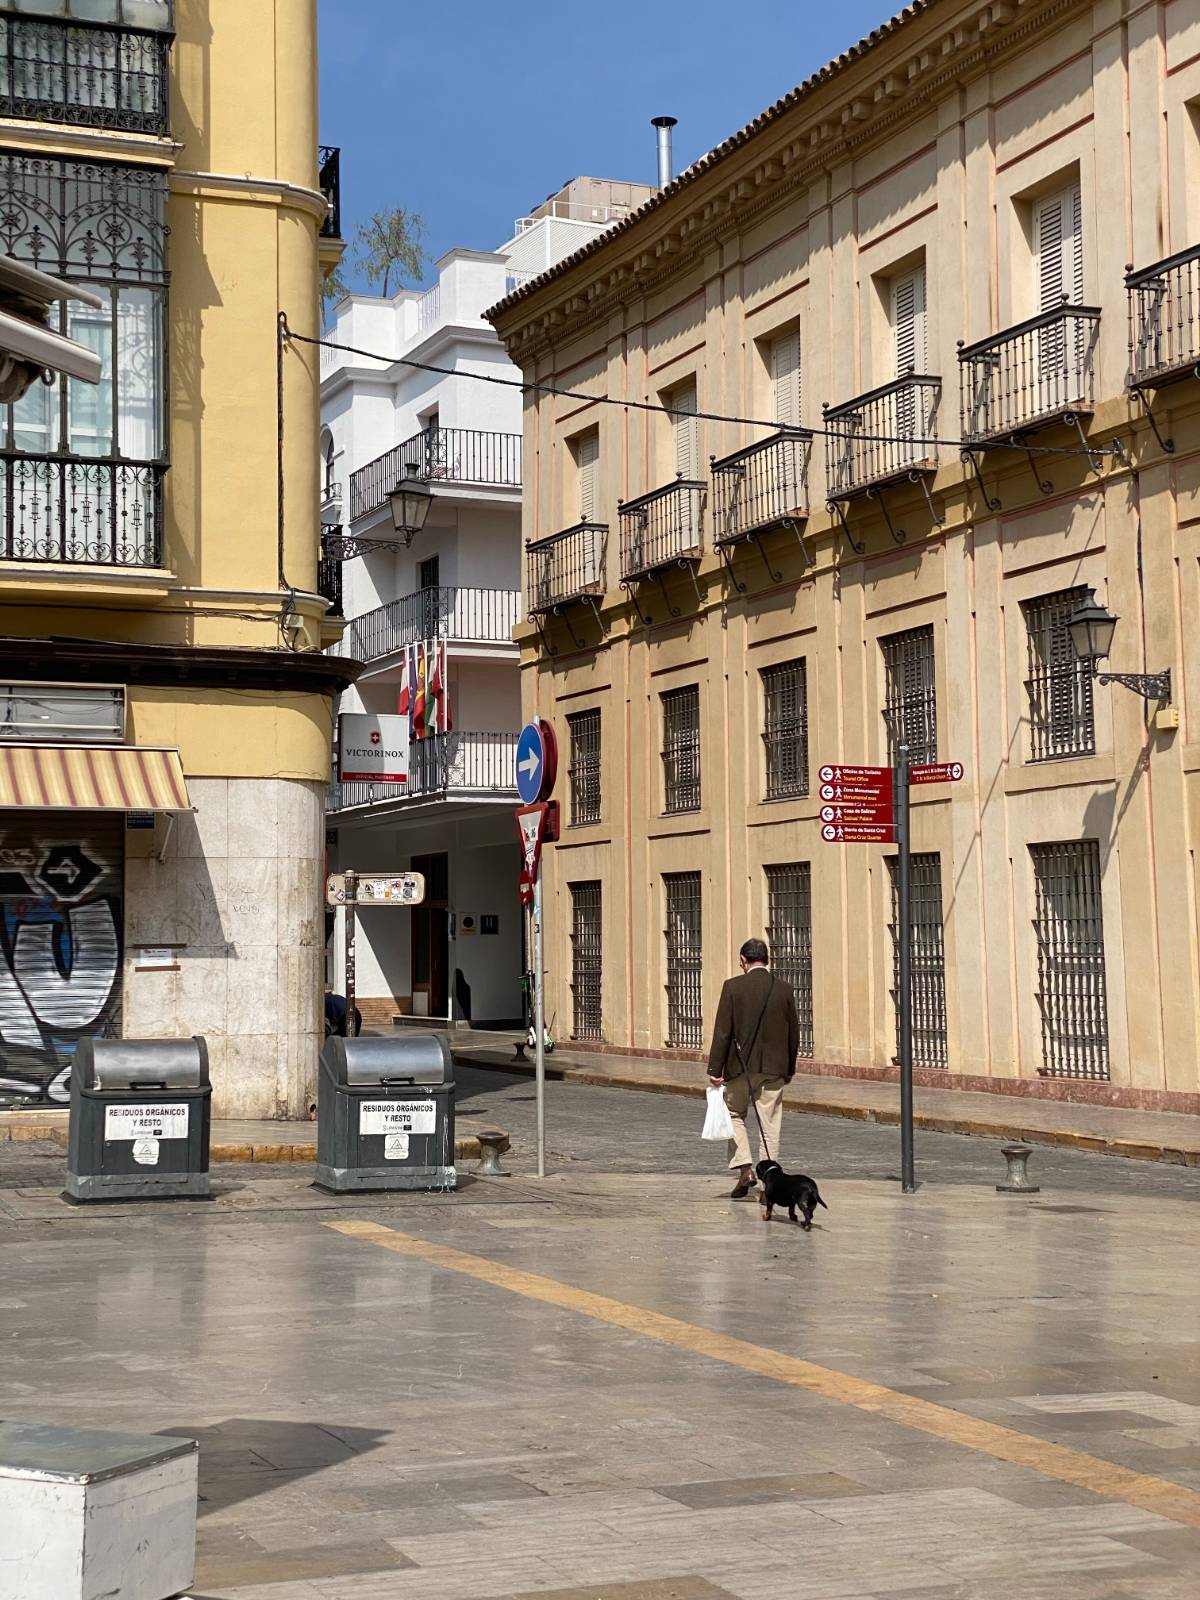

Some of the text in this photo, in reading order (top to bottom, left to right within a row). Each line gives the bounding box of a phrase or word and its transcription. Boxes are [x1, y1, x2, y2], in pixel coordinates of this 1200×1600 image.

[346, 748, 404, 758] VICTORINOX
[146, 1108, 186, 1116] ORGÁNICOS
[396, 1104, 433, 1112] ORGÁNICOS
